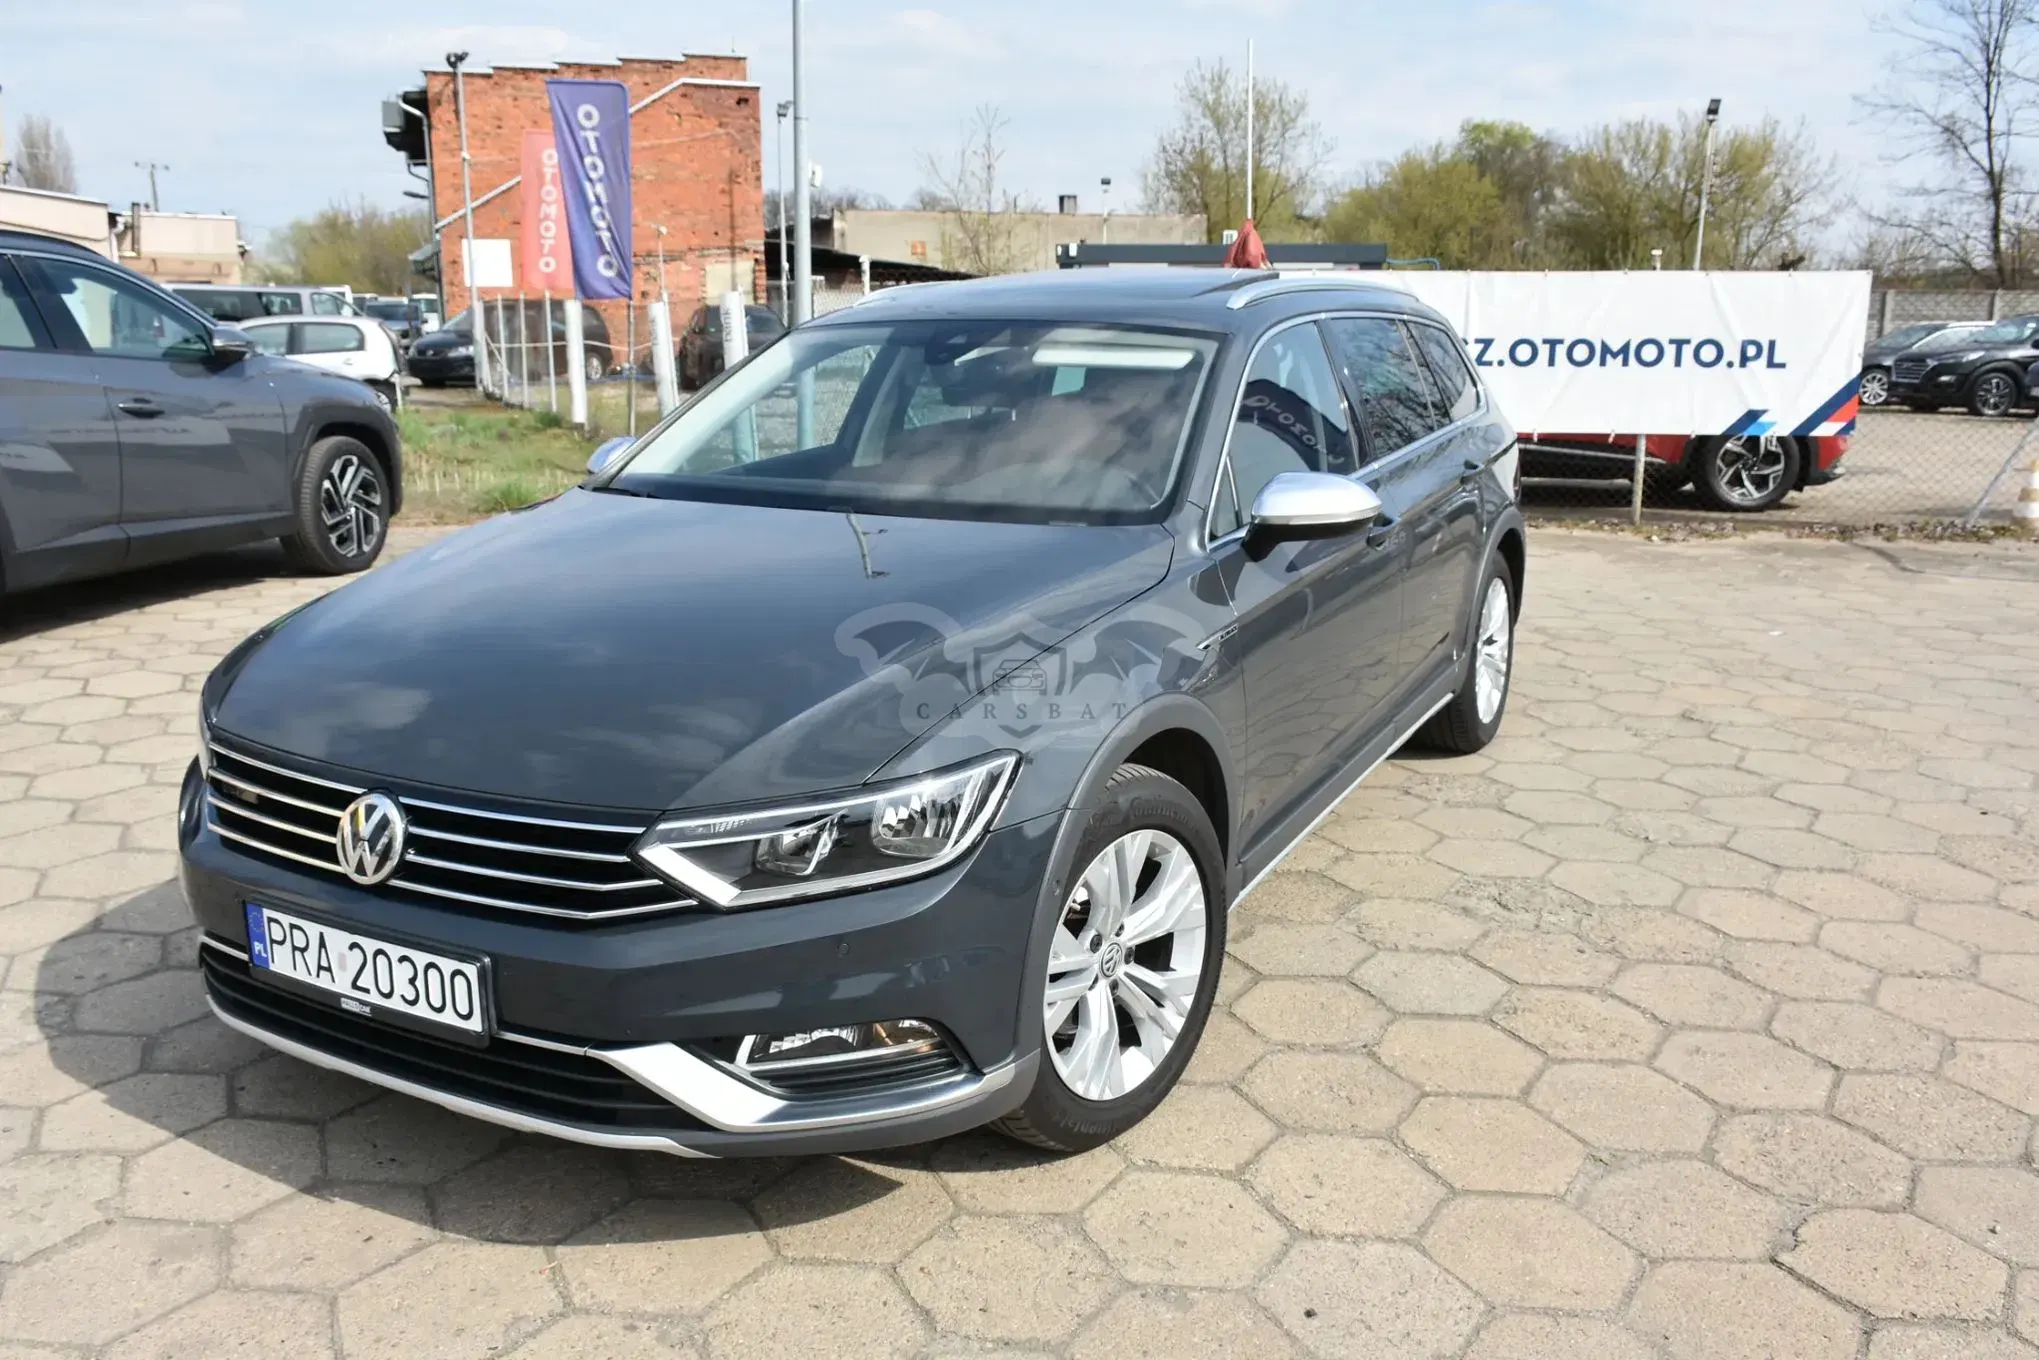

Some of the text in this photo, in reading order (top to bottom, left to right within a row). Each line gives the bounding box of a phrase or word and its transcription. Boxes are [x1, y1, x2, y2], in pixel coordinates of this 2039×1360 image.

[538, 148, 559, 273] OTOMOTO
[577, 103, 619, 277] OTOMOTO
[1461, 337, 1787, 369] Z.OTOMOTO.PL
[253, 941, 268, 959] PL
[266, 915, 474, 1022] PRA 20300
